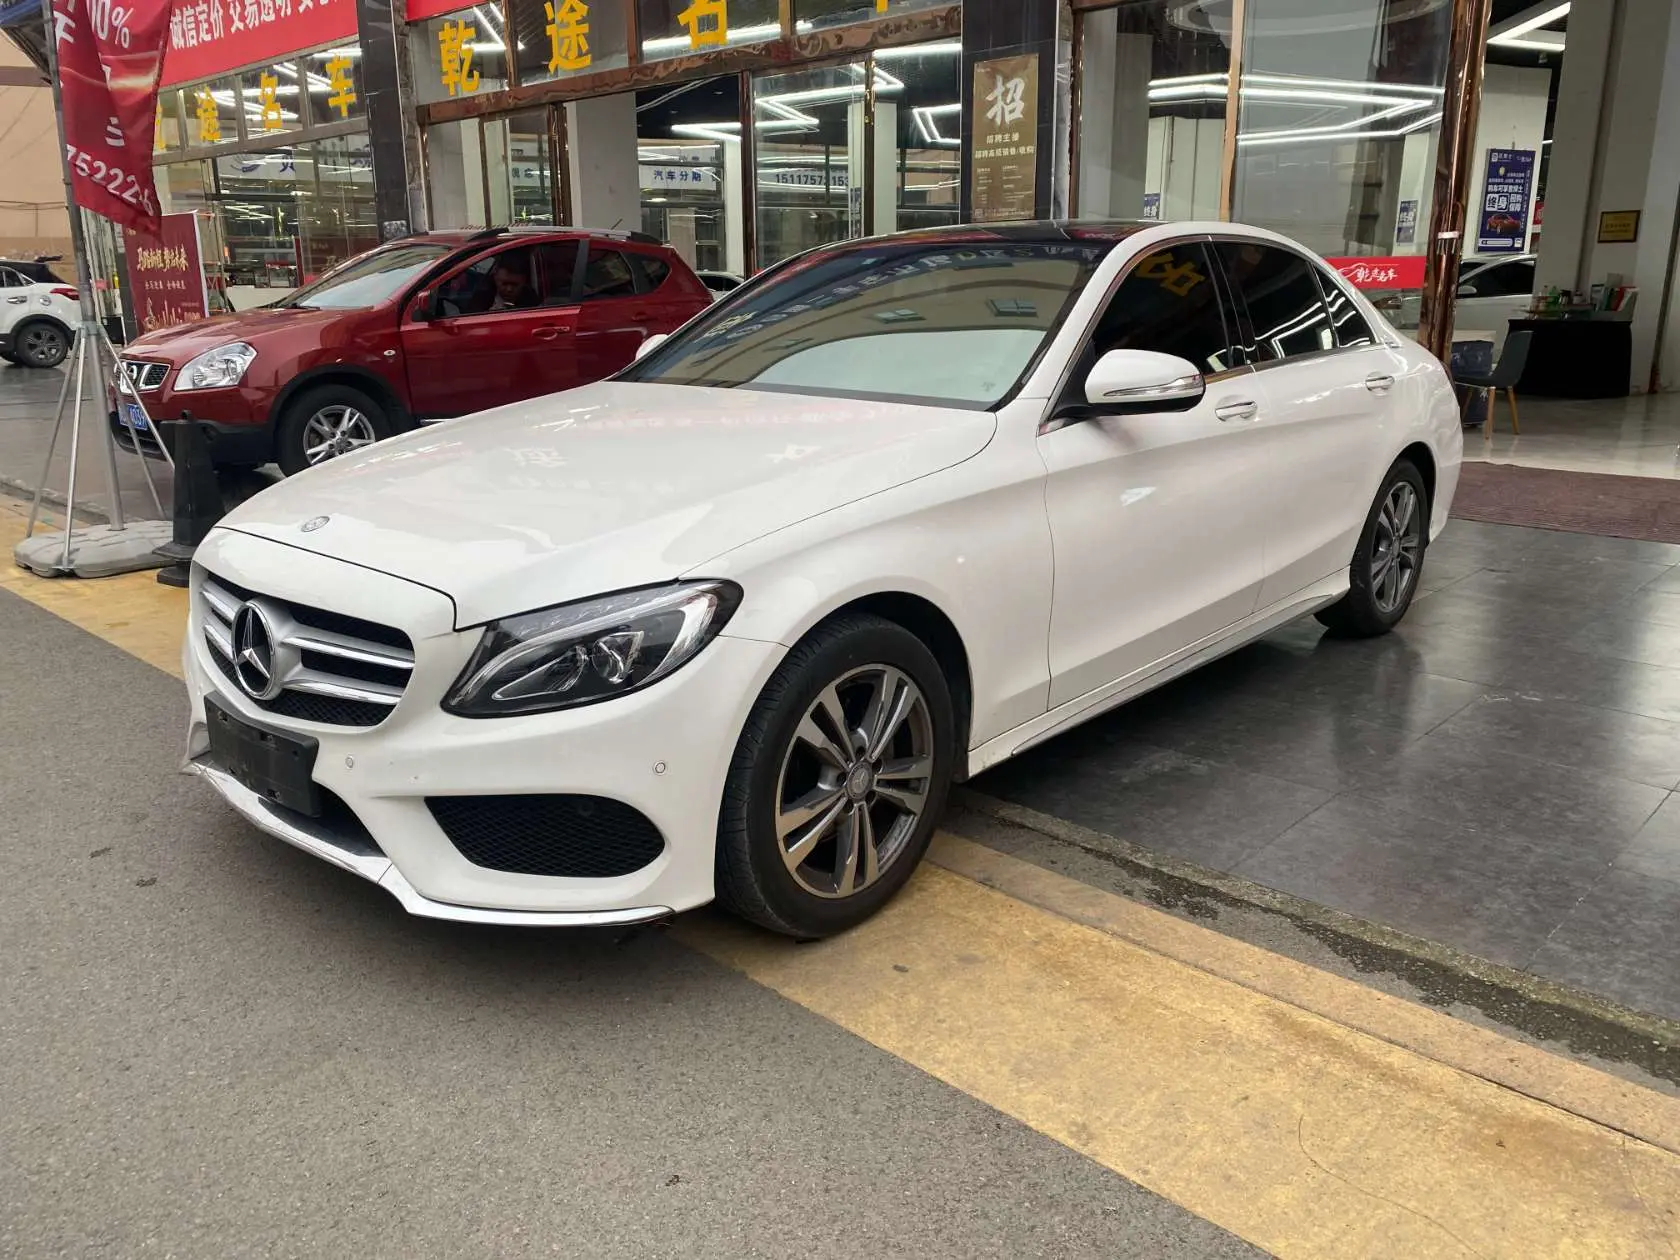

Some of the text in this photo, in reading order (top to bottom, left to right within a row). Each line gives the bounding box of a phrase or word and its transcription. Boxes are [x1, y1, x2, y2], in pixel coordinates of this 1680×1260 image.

[154, 52, 357, 150] 途名车
[985, 74, 1025, 126] 招
